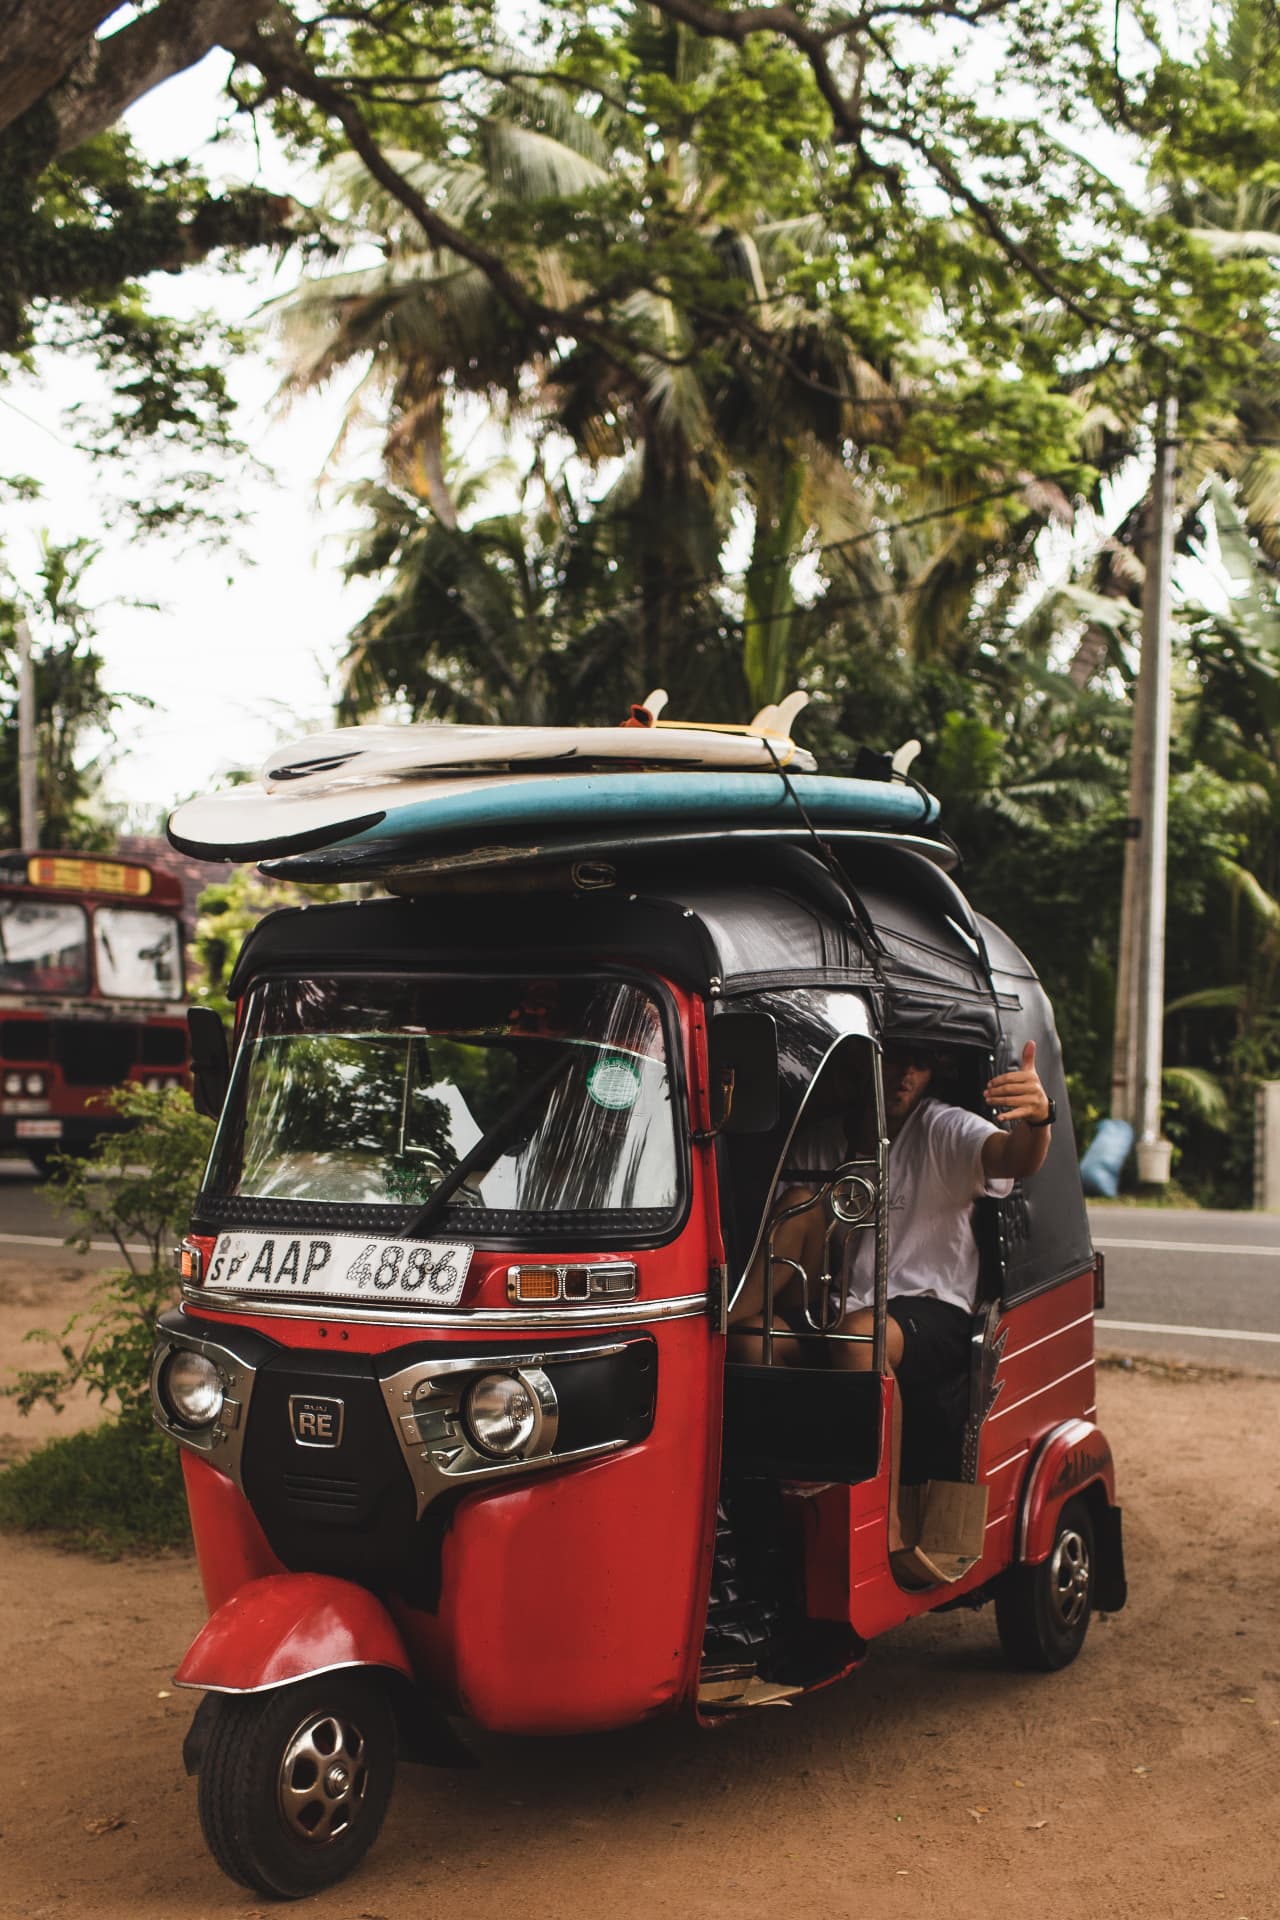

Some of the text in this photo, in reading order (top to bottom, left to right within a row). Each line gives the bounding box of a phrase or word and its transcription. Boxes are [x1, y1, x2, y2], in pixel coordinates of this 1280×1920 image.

[247, 1239, 332, 1285] AAP
[346, 1244, 458, 1295] 4886
[299, 1412, 333, 1437] RE
